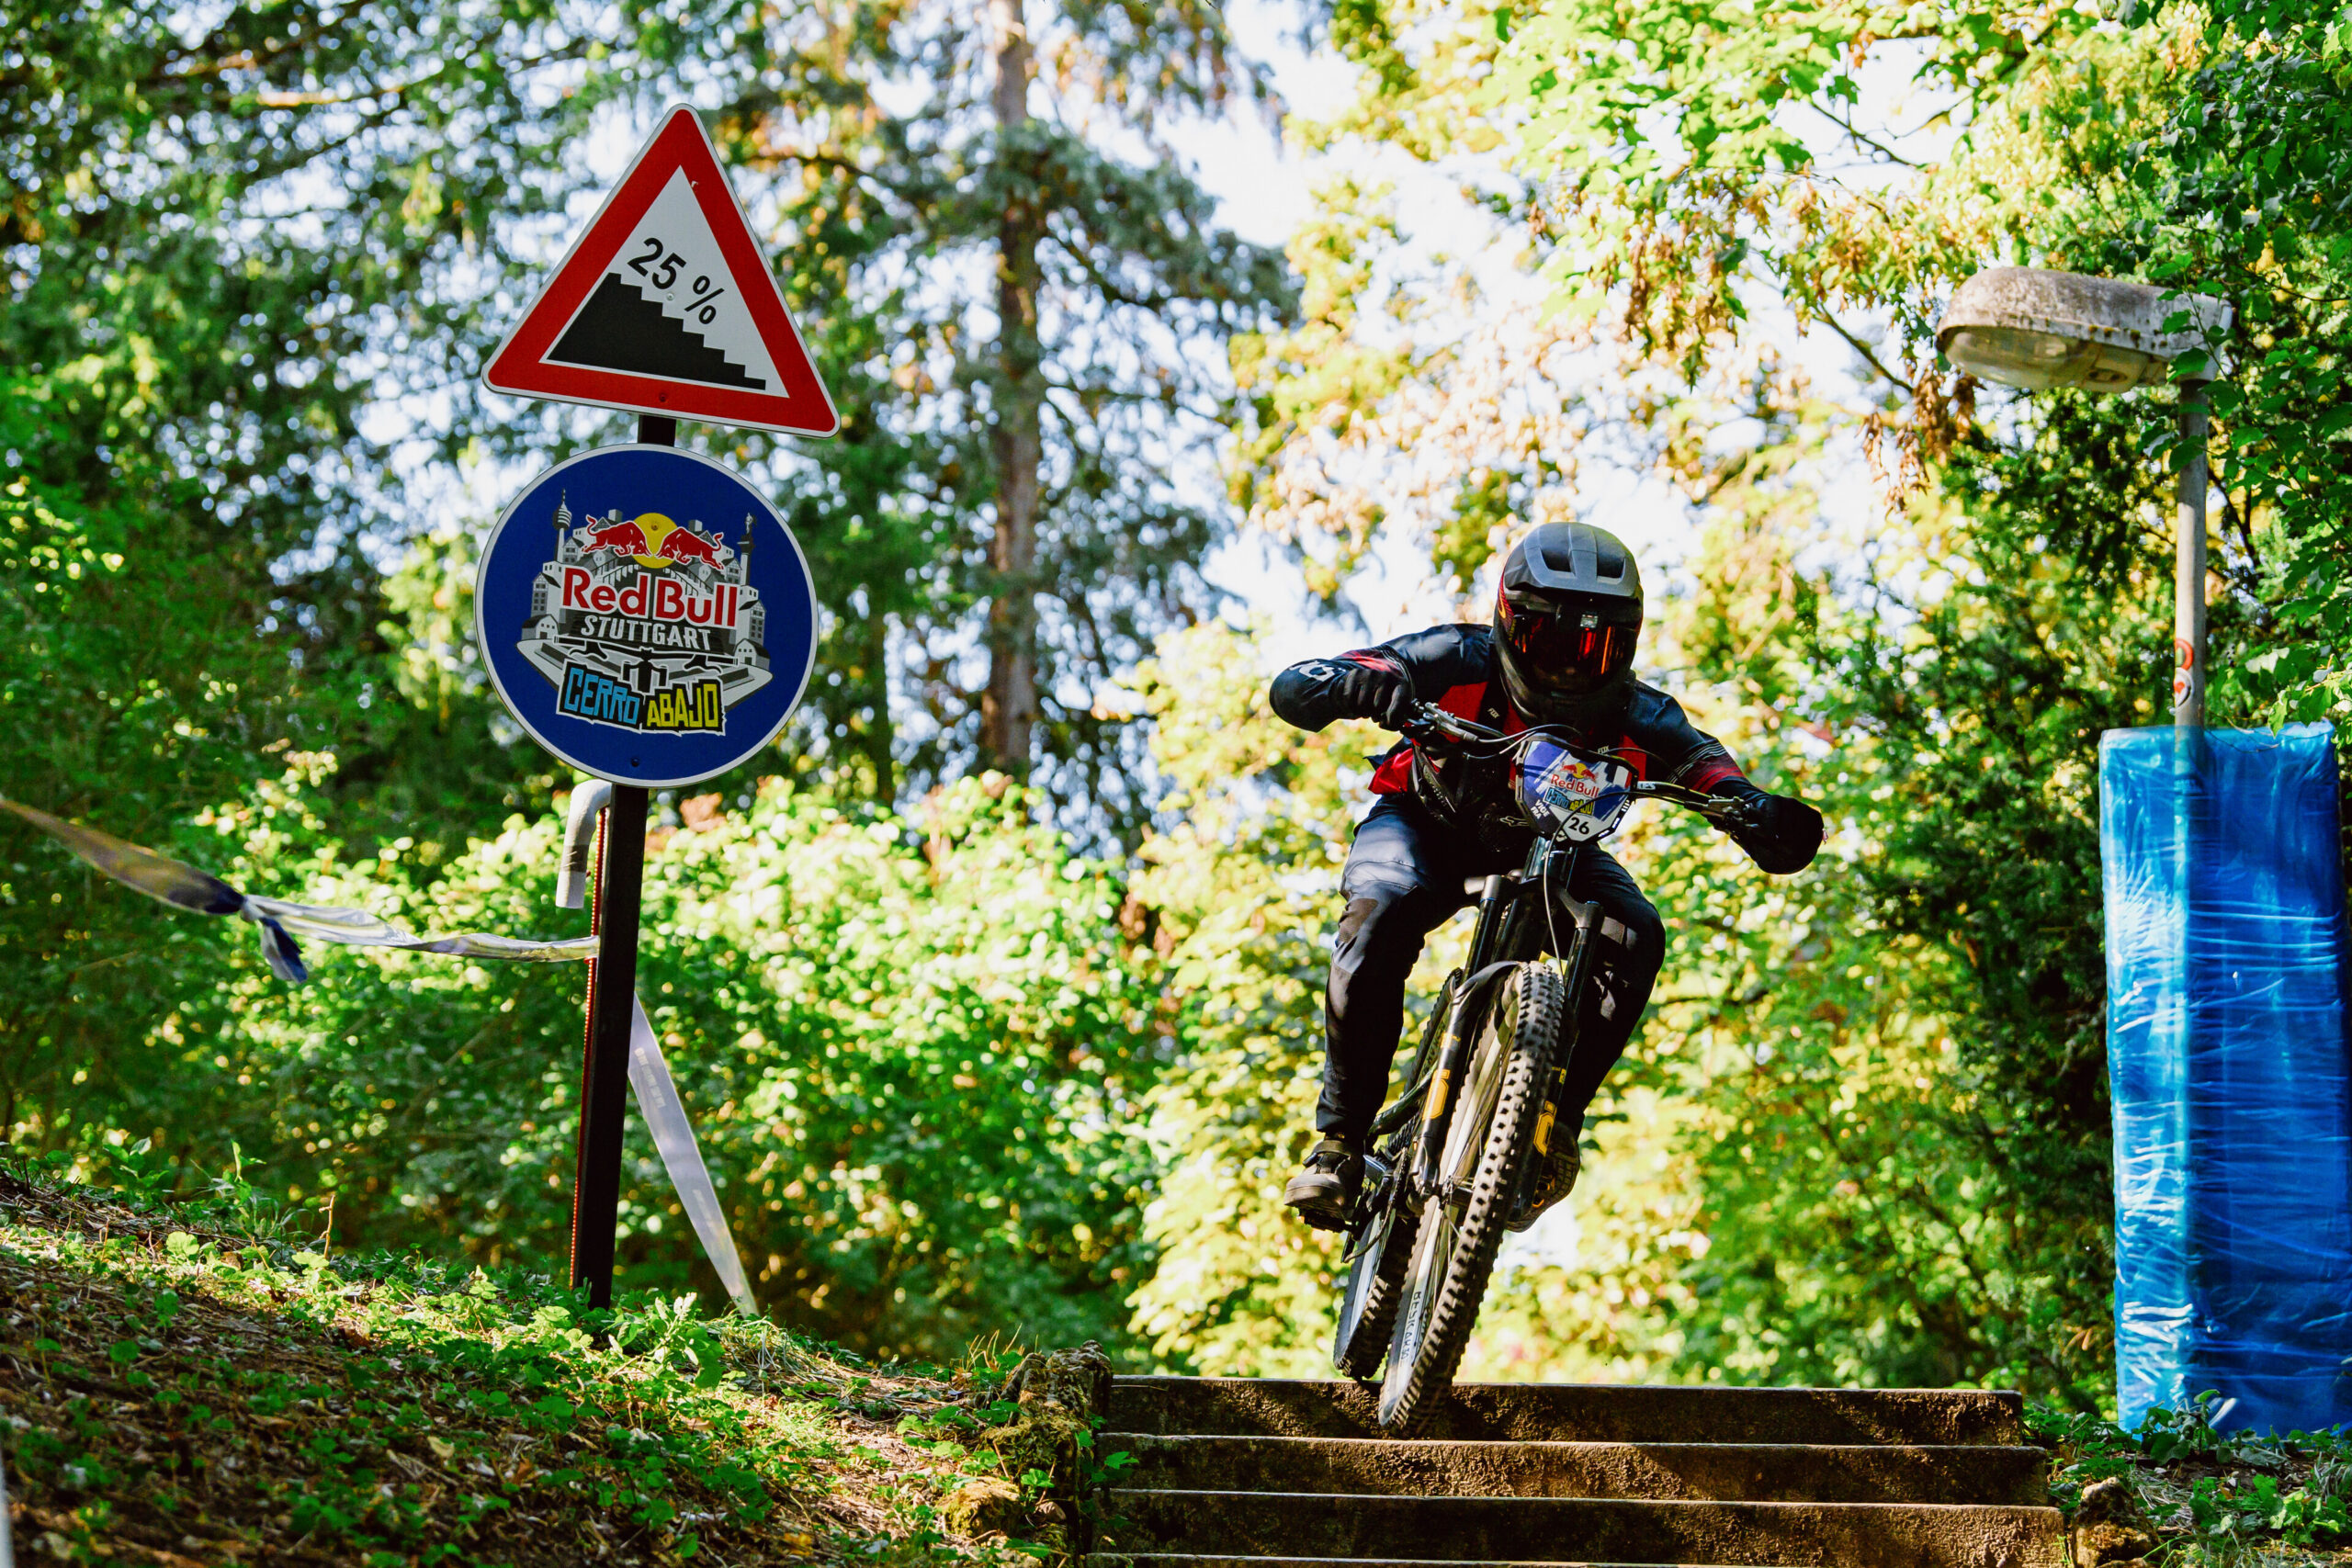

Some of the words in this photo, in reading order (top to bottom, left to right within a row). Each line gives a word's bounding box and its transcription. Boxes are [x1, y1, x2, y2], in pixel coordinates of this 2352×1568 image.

[628, 237, 686, 289] 25
[684, 275, 725, 325] %
[581, 615, 710, 650] STUTTGART
[564, 668, 640, 726] CERRO
[647, 683, 718, 728] ABAJO
[1568, 817, 1589, 835] 26
